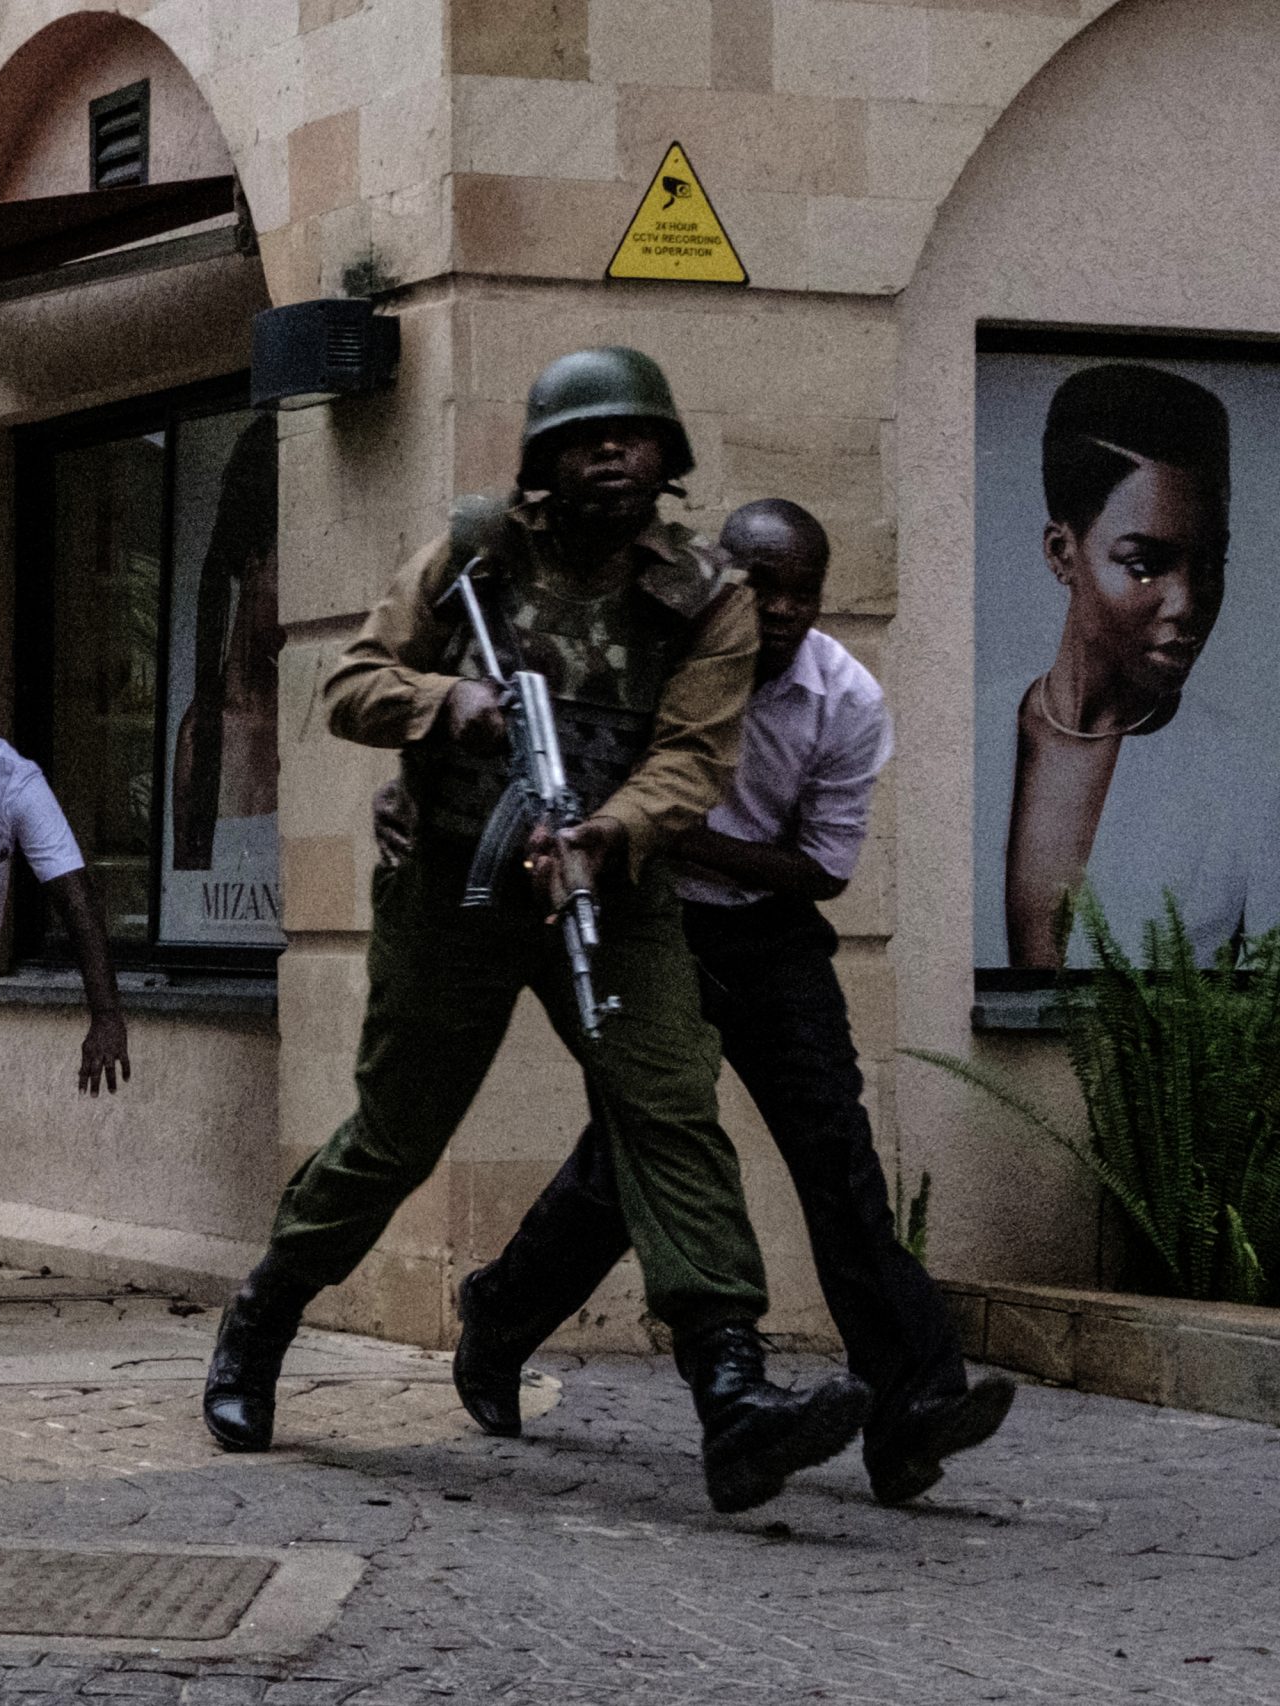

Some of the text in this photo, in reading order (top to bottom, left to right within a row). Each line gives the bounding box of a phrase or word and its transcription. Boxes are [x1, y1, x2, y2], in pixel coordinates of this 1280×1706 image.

[655, 221, 698, 232] 24 HOUR
[632, 233, 722, 245] CCTV RECORDING
[641, 246, 712, 257] IN OPERATION
